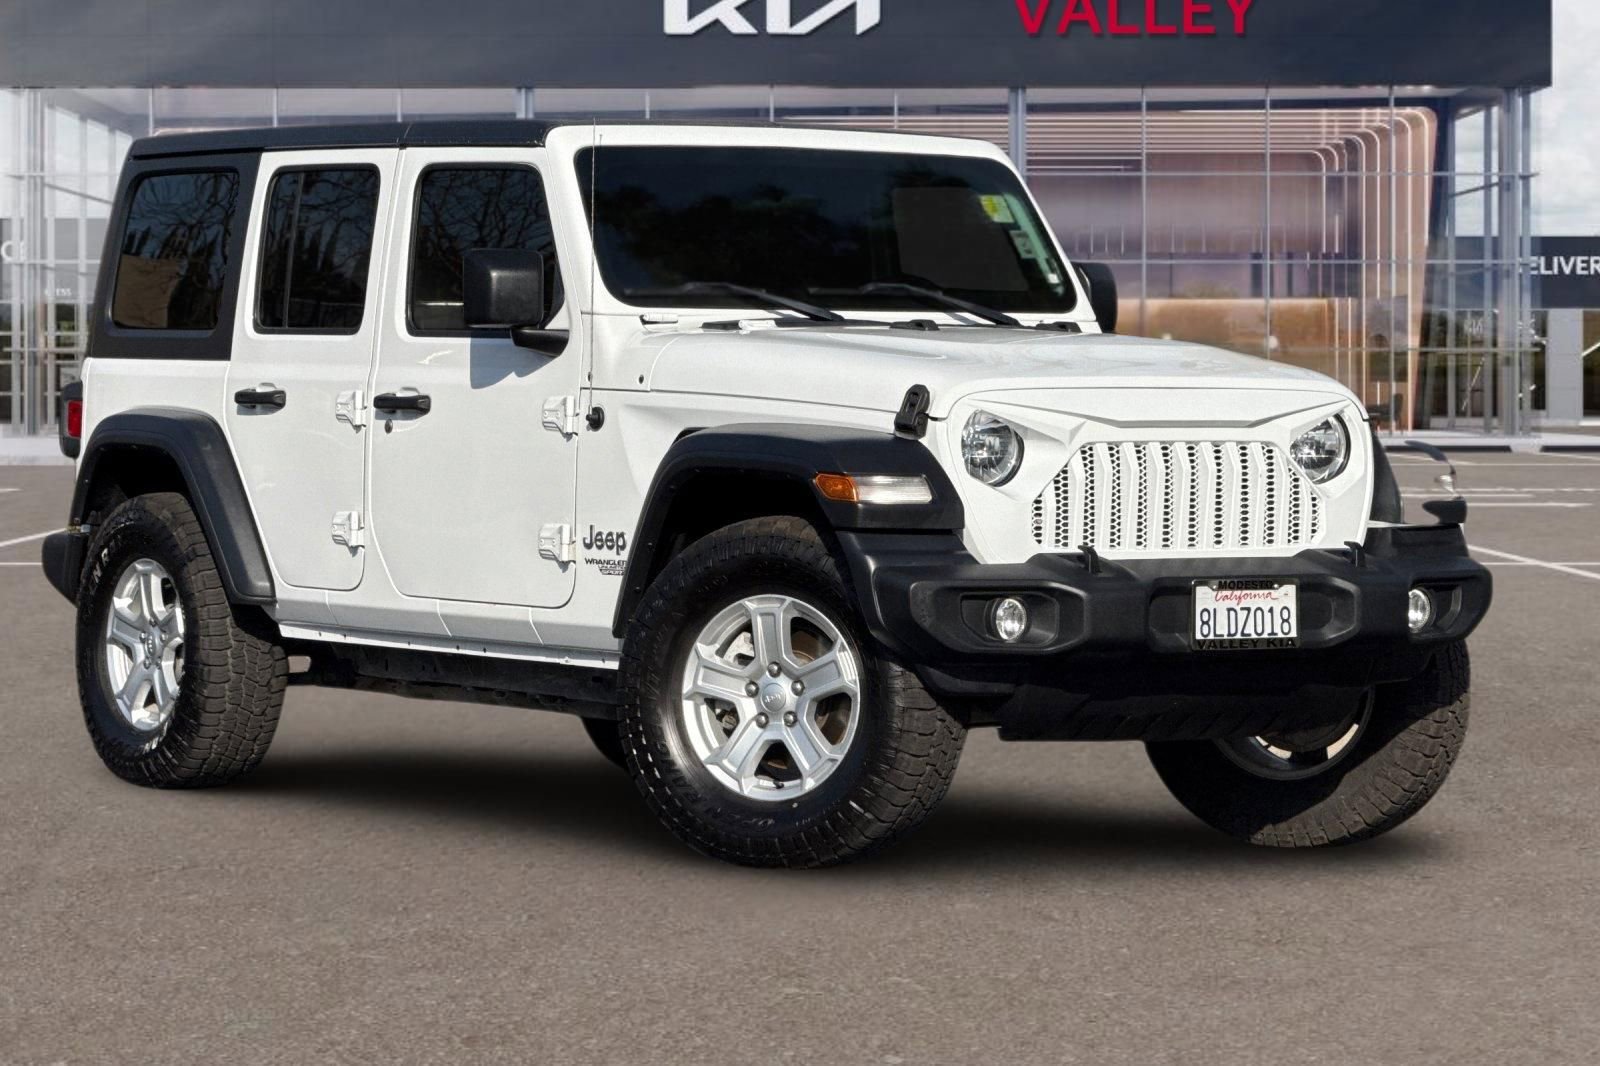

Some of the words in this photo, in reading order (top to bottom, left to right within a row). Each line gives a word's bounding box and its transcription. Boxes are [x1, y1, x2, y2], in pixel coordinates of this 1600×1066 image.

[1015, 0, 1253, 34] VALLEY
[1518, 255, 1600, 276] ELIVER
[582, 524, 627, 556] Jeep
[584, 557, 628, 566] WRANGLER
[1217, 580, 1274, 590] MODESTO
[1214, 590, 1279, 605] California
[1199, 605, 1292, 638] 8LDZ018
[1197, 639, 1260, 649] VALLEY
[1266, 638, 1297, 648] KIA
